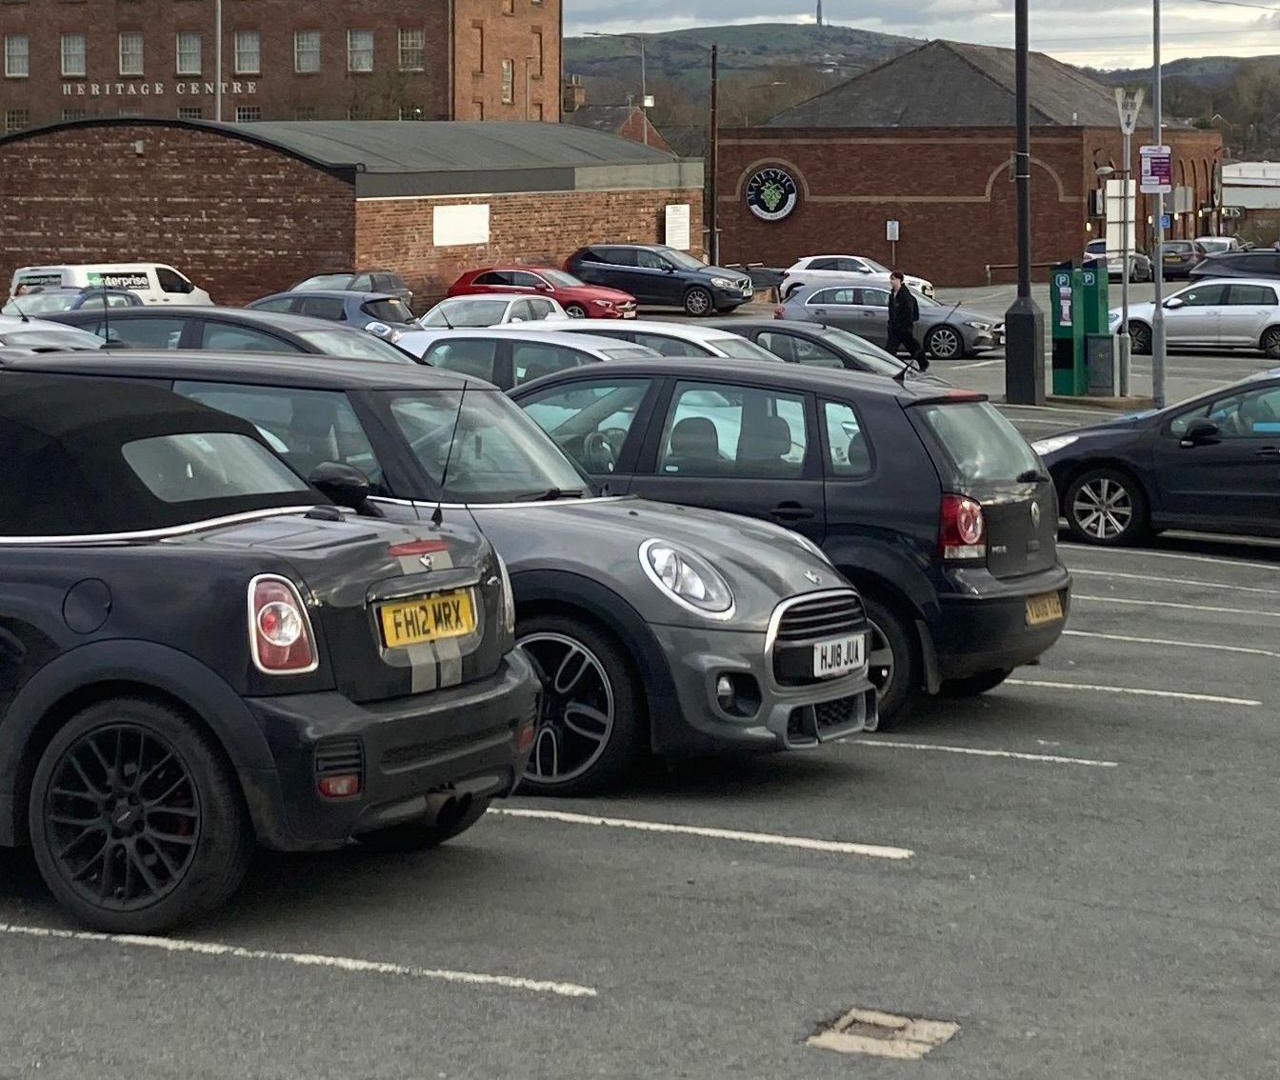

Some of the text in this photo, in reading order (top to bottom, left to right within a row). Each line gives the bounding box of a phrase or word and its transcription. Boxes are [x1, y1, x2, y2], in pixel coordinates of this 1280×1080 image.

[62, 81, 257, 96] HERITAGE CENTRE
[747, 170, 793, 201] MAJESTIC
[393, 599, 464, 641] FH12 MRX
[820, 643, 842, 671] HJ18
